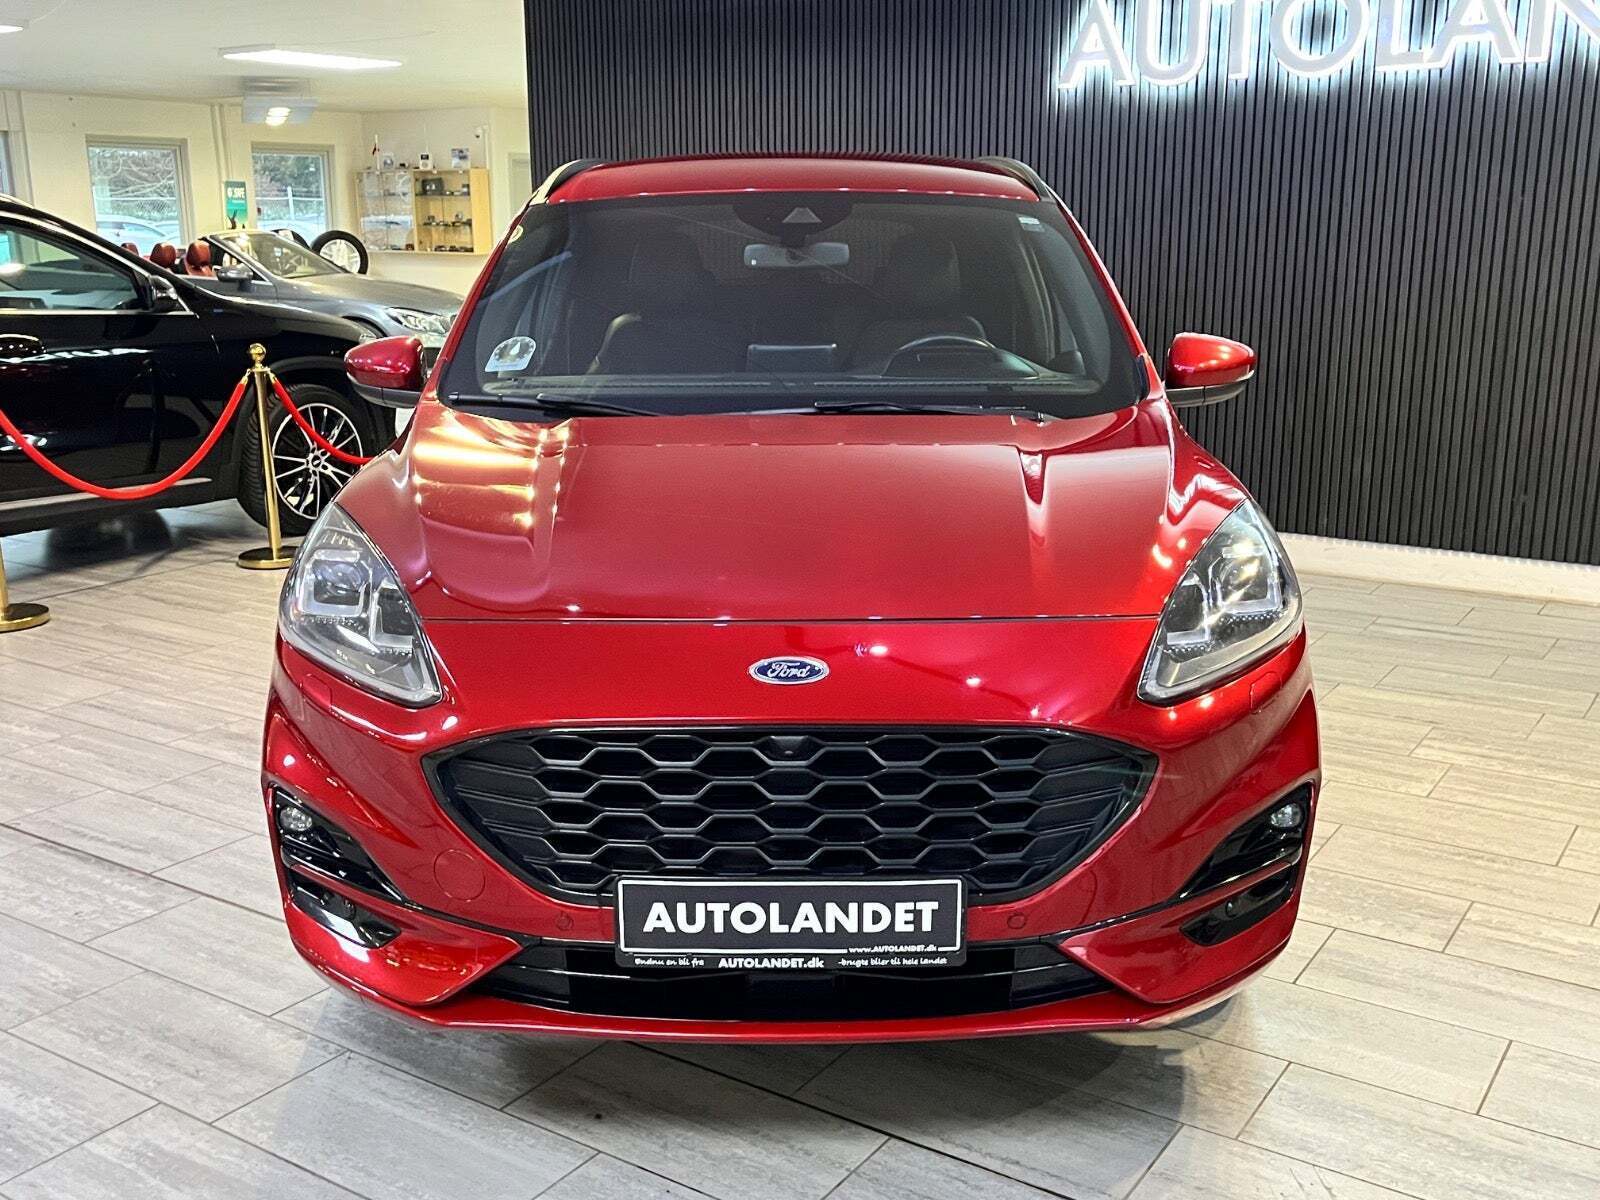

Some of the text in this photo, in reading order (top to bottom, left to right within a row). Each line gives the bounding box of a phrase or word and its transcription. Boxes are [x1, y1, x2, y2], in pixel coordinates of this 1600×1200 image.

[767, 662, 811, 678] Ford
[643, 901, 939, 934] AUTOLANDET
[848, 944, 937, 953] www.AUTOLANDET.dk
[665, 959, 678, 967] en
[718, 957, 825, 969] AUTOLANDET.dk
